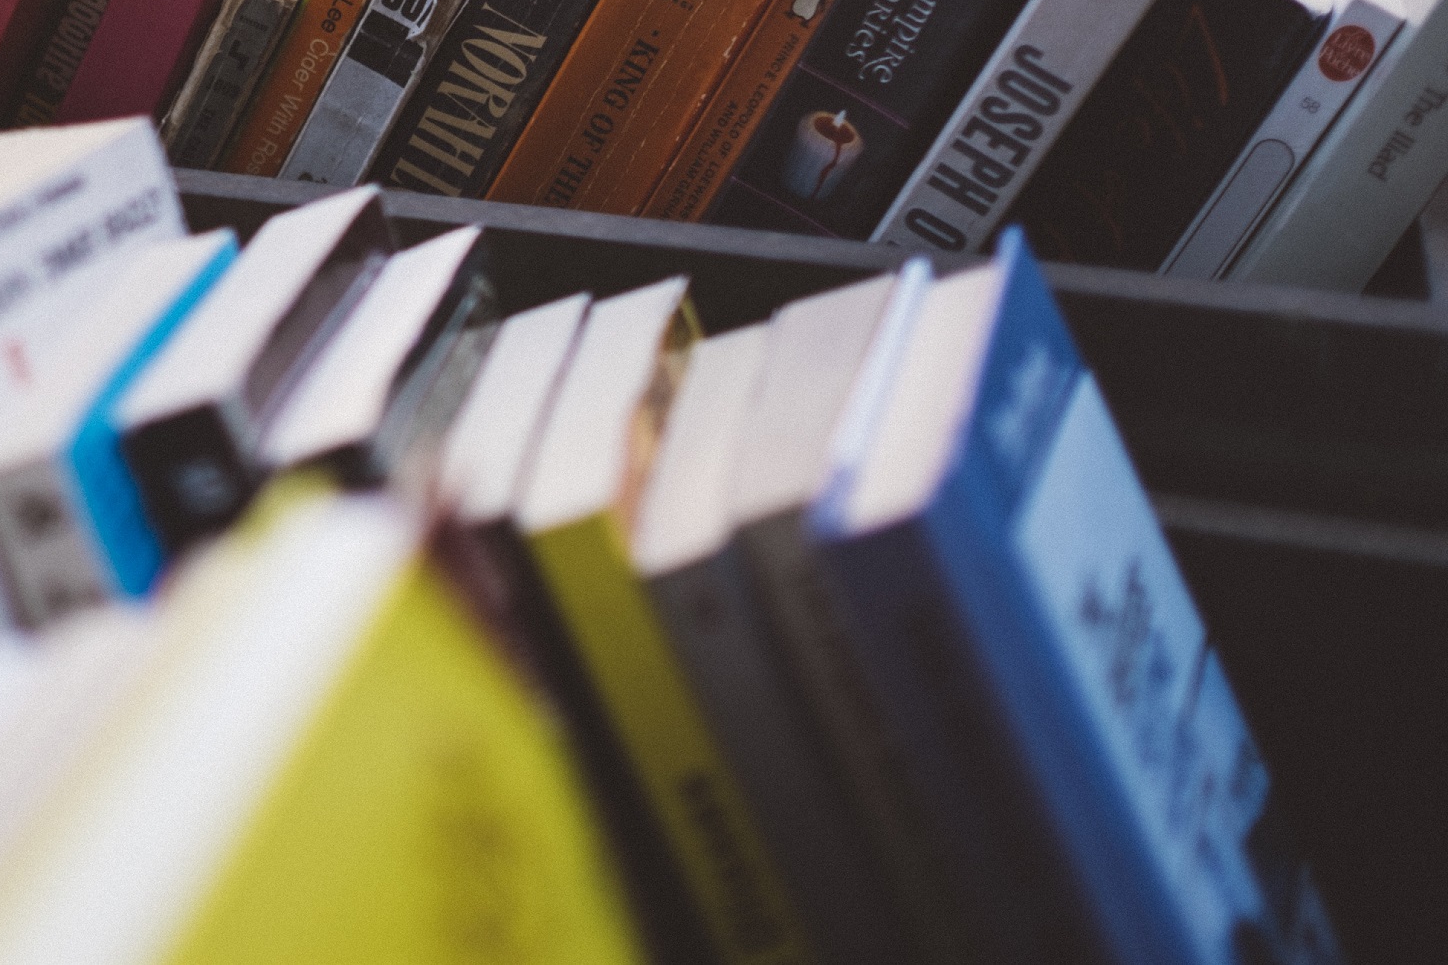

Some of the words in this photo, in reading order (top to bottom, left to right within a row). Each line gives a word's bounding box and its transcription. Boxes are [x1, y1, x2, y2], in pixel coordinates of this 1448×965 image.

[296, 38, 330, 92] Cider
[604, 38, 661, 112] KING
[769, 33, 800, 79] PRINCE
[408, 1, 547, 177] NORAH
[723, 100, 740, 122] AND
[733, 80, 772, 143] LEOPOLD
[1407, 85, 1448, 128] The
[263, 91, 305, 147] With
[585, 111, 616, 153] OF
[928, 43, 1074, 218] JOSEPH
[721, 139, 737, 156] OF
[1367, 129, 1416, 184] Iliad
